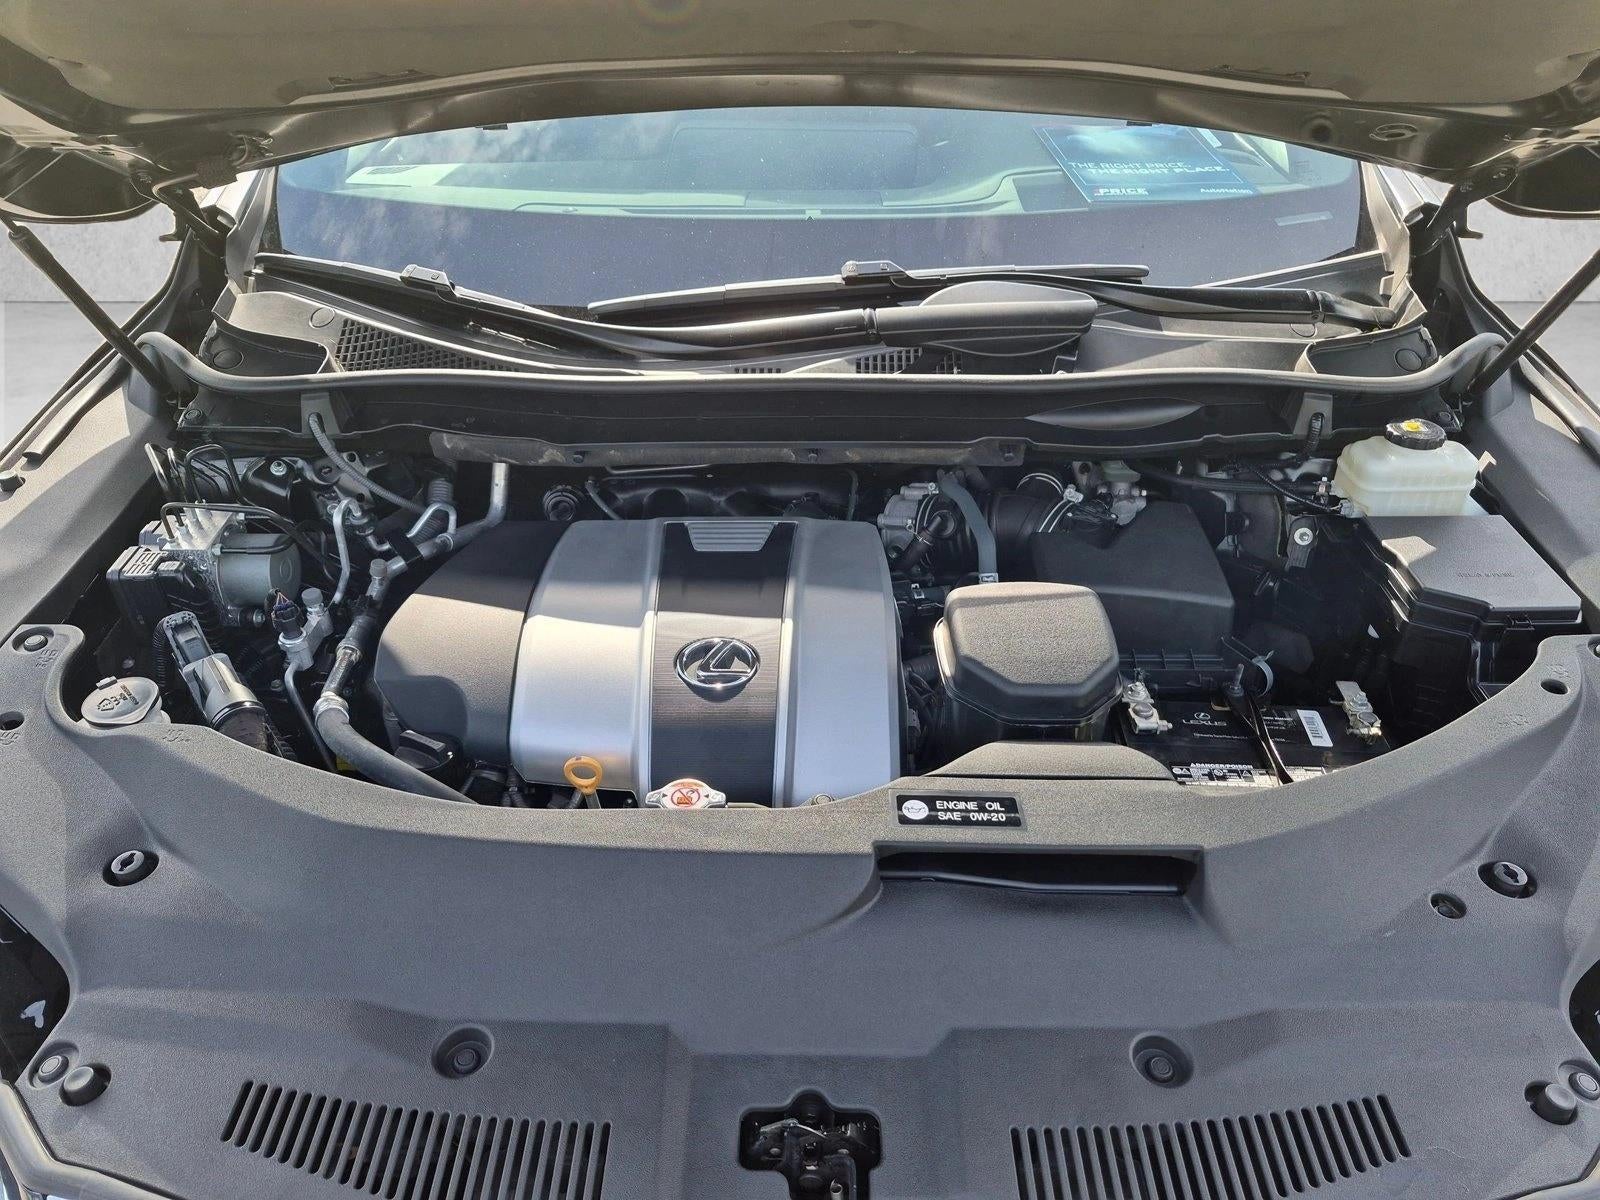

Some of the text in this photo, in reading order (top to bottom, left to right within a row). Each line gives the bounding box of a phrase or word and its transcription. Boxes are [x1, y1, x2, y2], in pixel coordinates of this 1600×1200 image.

[935, 800, 1005, 811] ENGINE OIL
[937, 811, 1006, 822] SAE 0W-20
